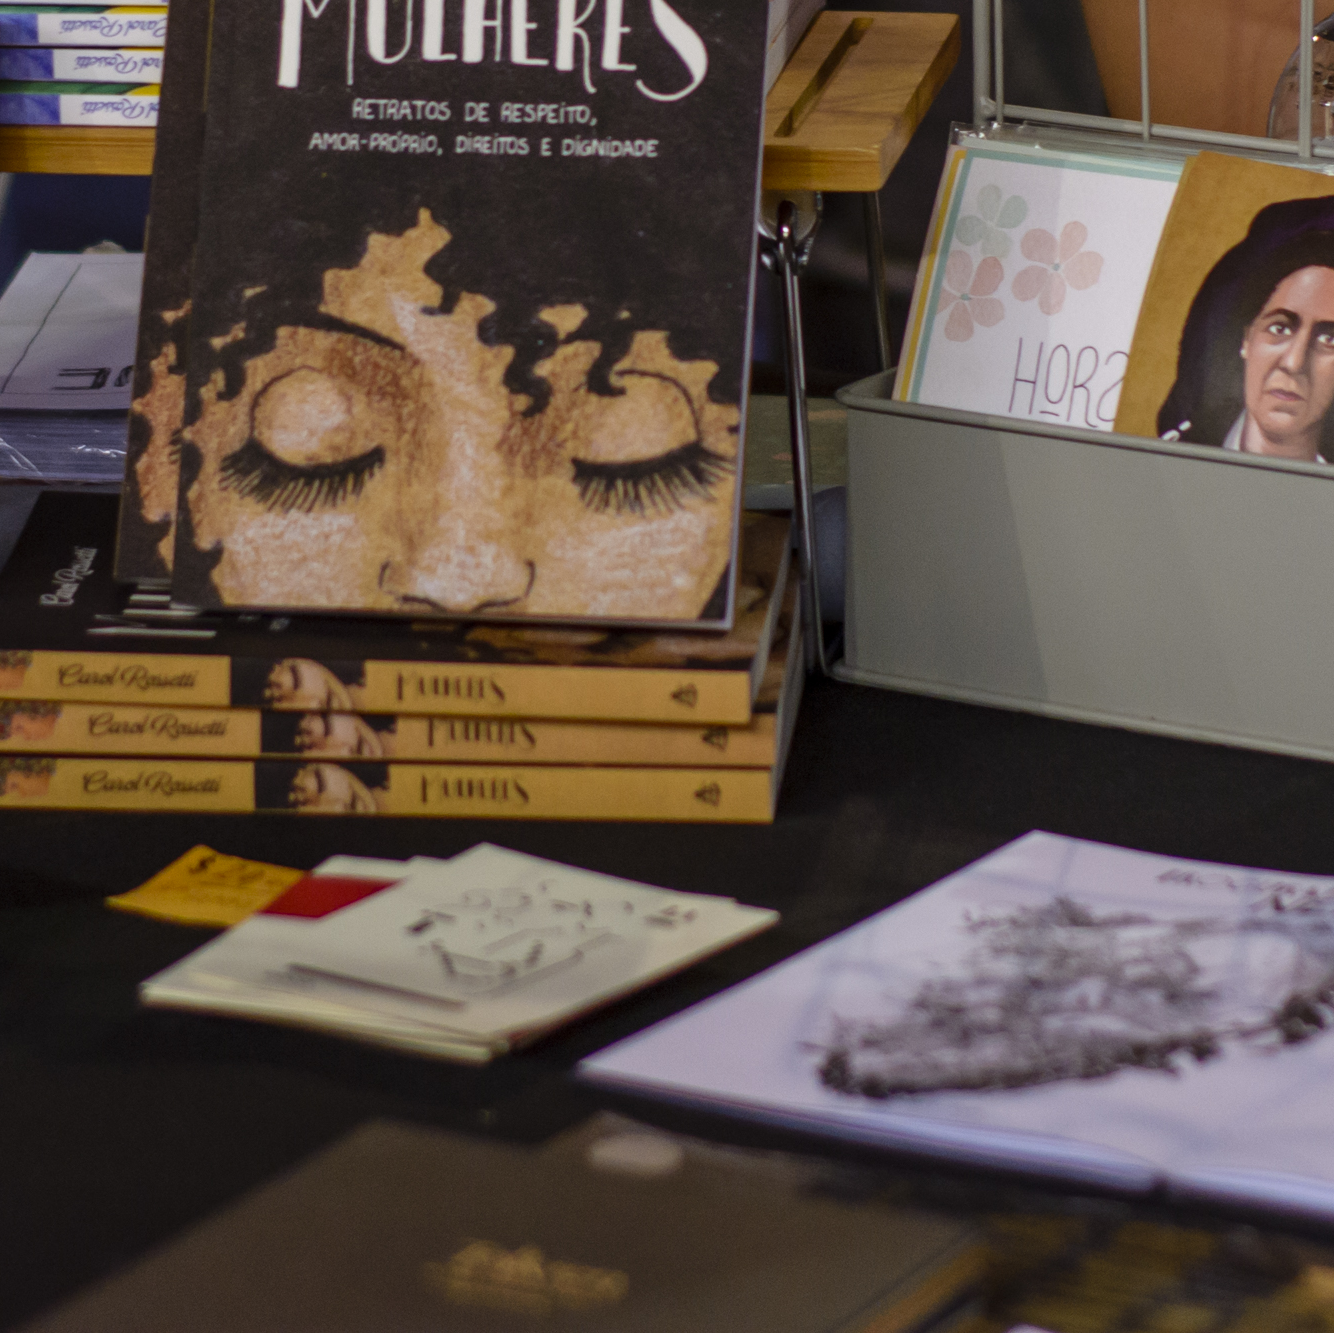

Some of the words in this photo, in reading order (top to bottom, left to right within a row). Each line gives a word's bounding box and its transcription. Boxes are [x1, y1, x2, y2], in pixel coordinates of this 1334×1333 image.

[353, 98, 451, 122] RETRATOS
[465, 102, 490, 123] DE
[501, 101, 598, 126] RESPEITO,
[309, 130, 443, 156] AMOR-PRÓPRIO,
[455, 131, 530, 155] DIREITOS
[540, 137, 552, 156] E
[562, 135, 659, 158] DIGNIDADE
